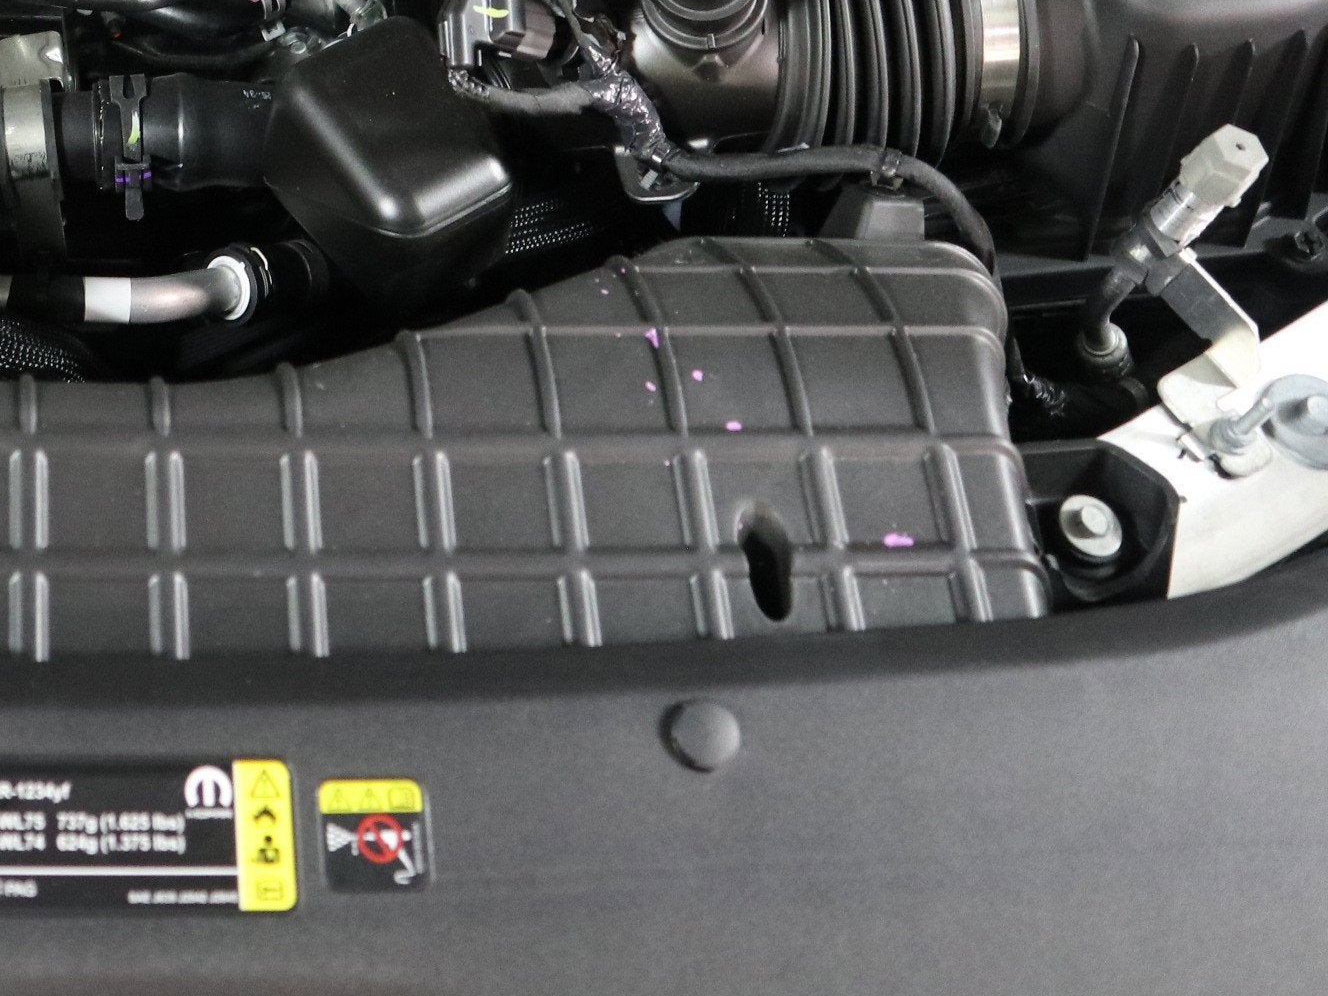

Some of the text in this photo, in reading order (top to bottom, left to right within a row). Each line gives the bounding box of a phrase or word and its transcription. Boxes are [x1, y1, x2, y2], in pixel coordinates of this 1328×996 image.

[56, 812, 99, 835] 737g
[152, 812, 186, 835] lbs)
[56, 833, 99, 855] 624g
[152, 833, 187, 855] lbs)
